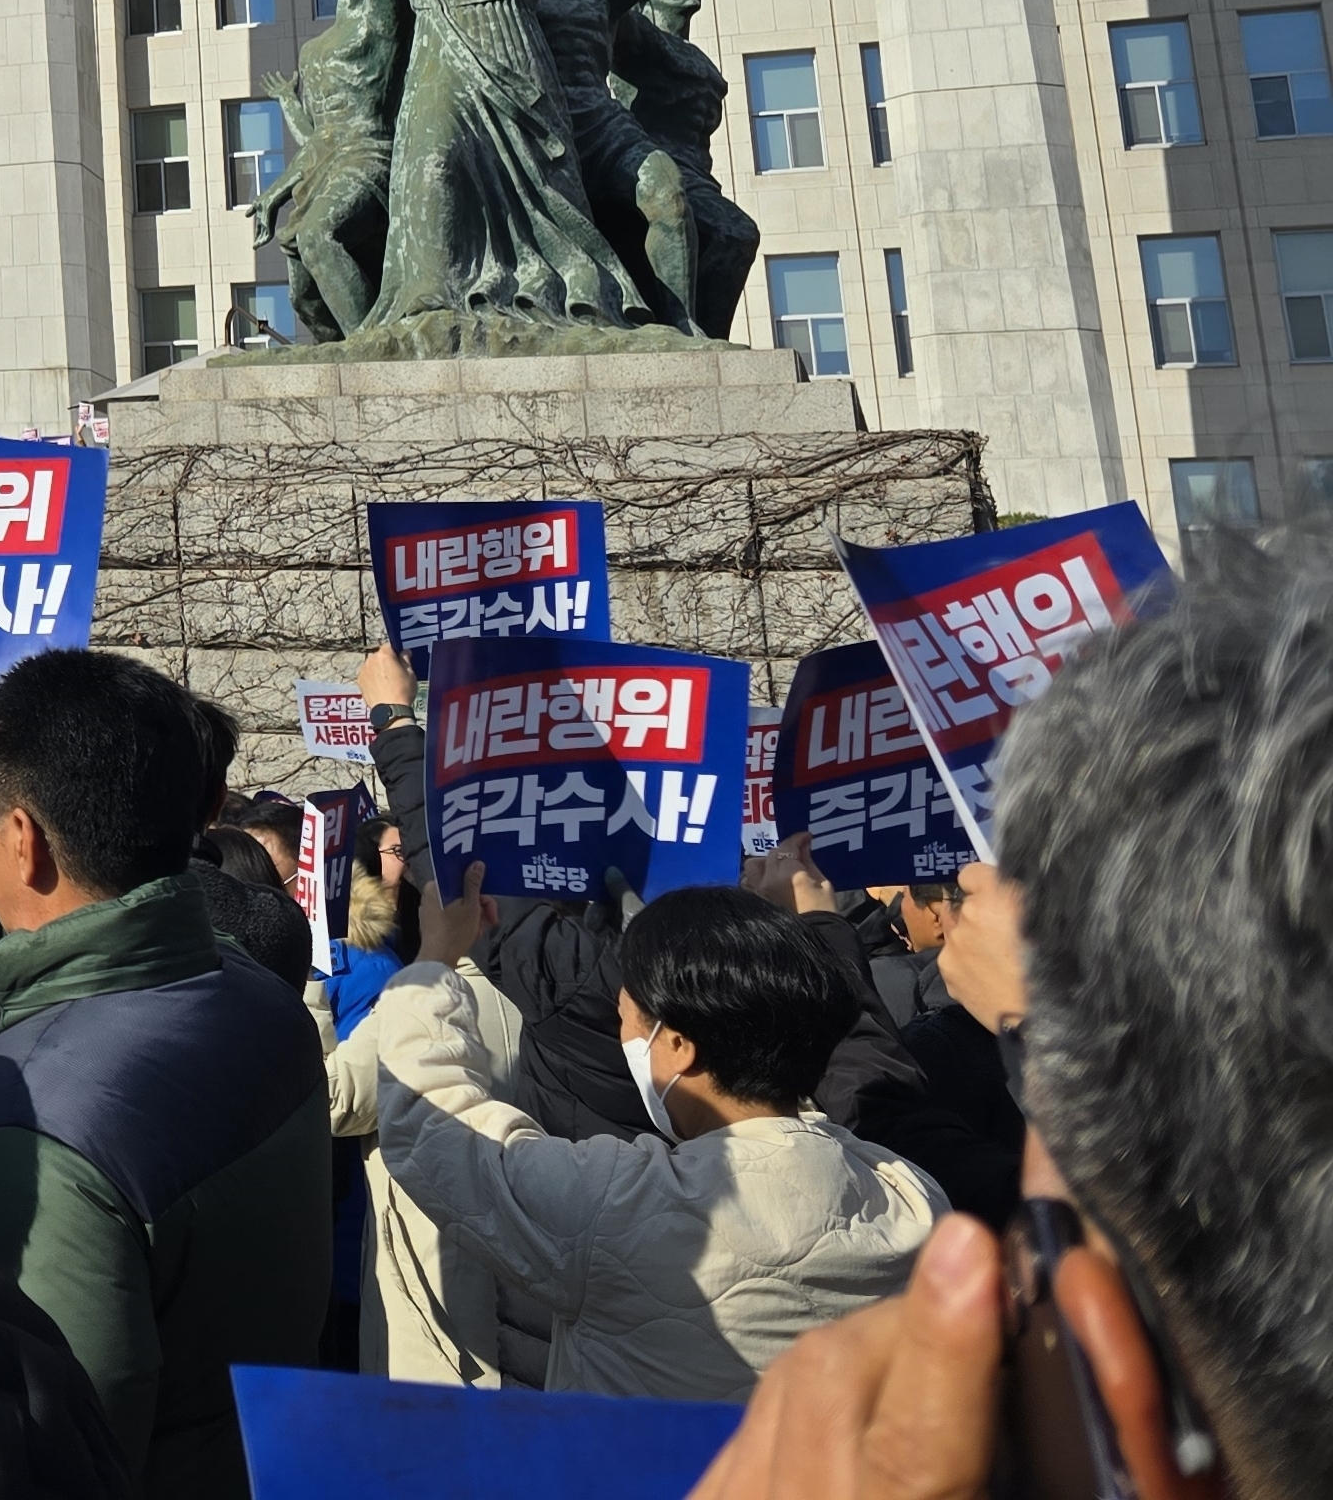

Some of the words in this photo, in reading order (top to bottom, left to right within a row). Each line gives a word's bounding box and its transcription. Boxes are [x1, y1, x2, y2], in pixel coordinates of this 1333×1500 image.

[394, 518, 568, 592] 내란행위
[399, 580, 590, 654] 즉각수사!
[309, 696, 371, 721] 윤석열
[443, 678, 693, 769] 내란행위
[442, 770, 719, 855] 즉각수사!
[522, 864, 589, 893] 민주당
